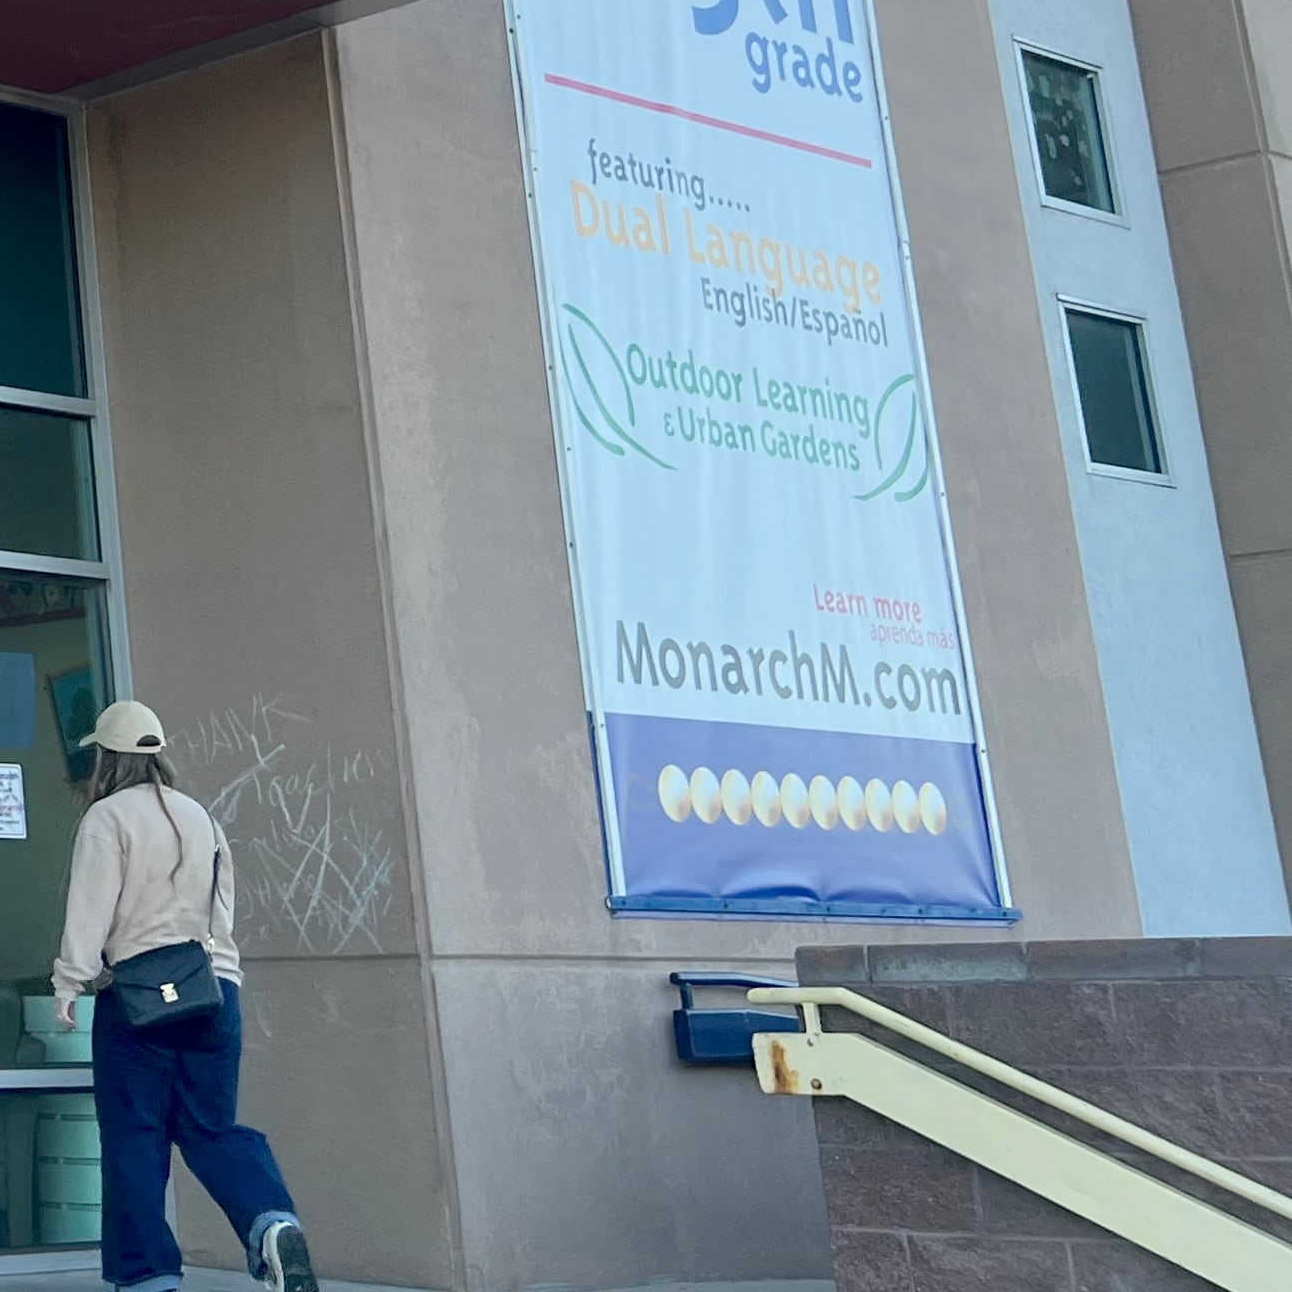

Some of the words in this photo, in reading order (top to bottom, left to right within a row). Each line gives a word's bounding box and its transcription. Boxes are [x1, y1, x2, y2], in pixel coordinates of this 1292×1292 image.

[744, 31, 863, 103] grade
[570, 179, 670, 255] Dual
[684, 208, 883, 313] Language
[701, 277, 888, 347] English/Español
[626, 343, 743, 403] Outdoor
[752, 366, 870, 440] Learning
[677, 406, 756, 452] Urban
[761, 420, 860, 471] Gardens
[813, 584, 868, 617] Learn
[873, 596, 922, 623] more
[870, 622, 924, 646] aprenda
[615, 619, 962, 715] MonarchM.com
